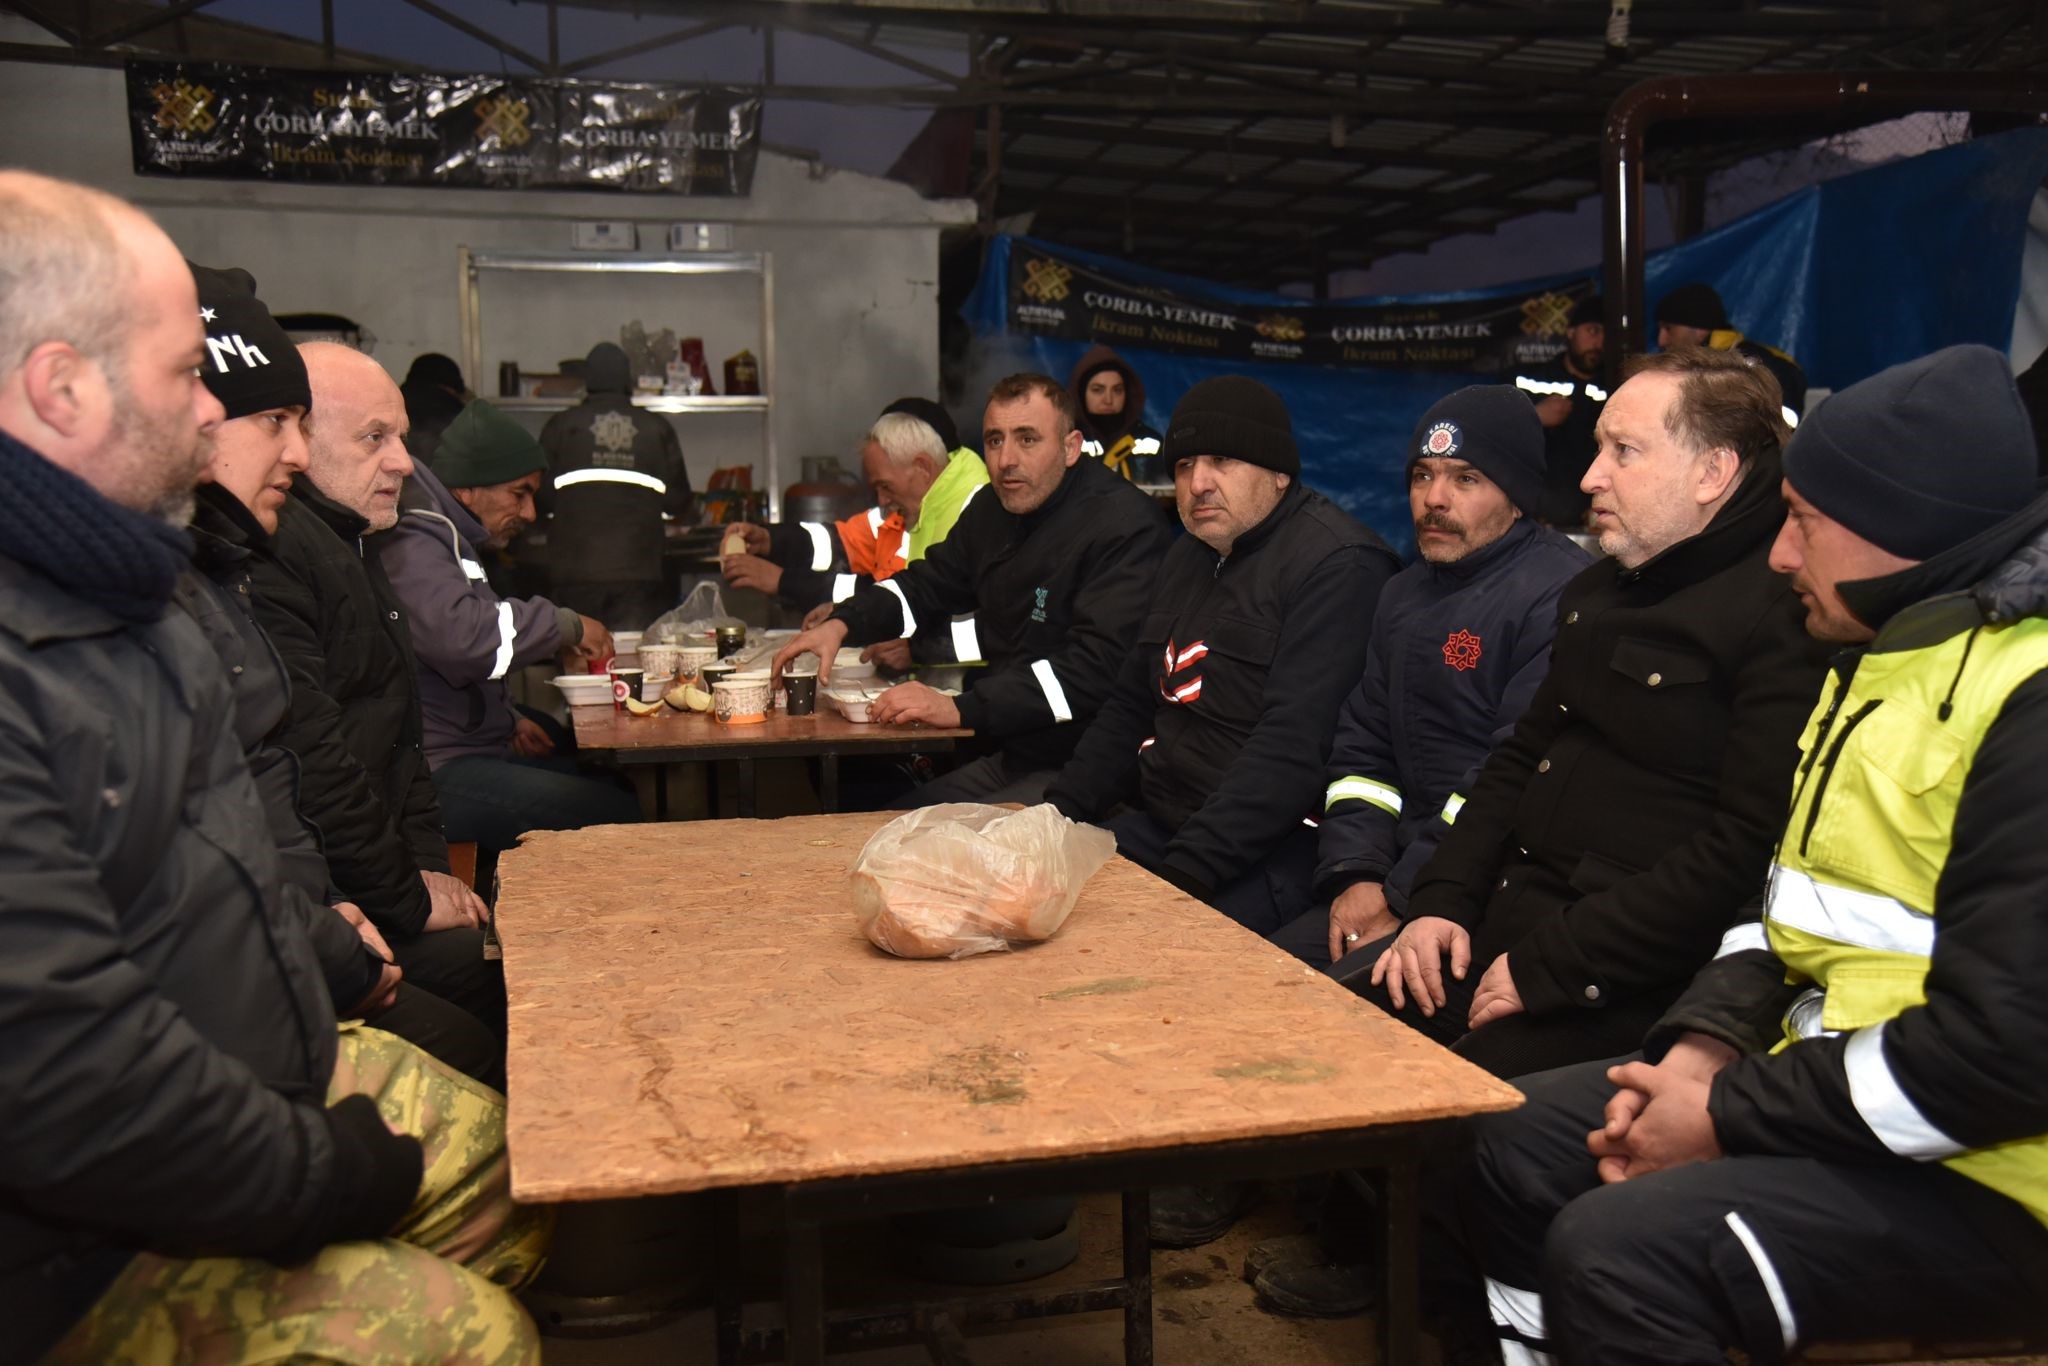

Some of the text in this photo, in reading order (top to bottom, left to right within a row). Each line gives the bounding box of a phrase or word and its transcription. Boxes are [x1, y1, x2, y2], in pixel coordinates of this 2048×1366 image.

[1083, 290, 1237, 331] ÇORBA-YEMEK
[1092, 314, 1219, 348] İkram Noktası
[1331, 323, 1491, 343] ÇORBA-YEMEK
